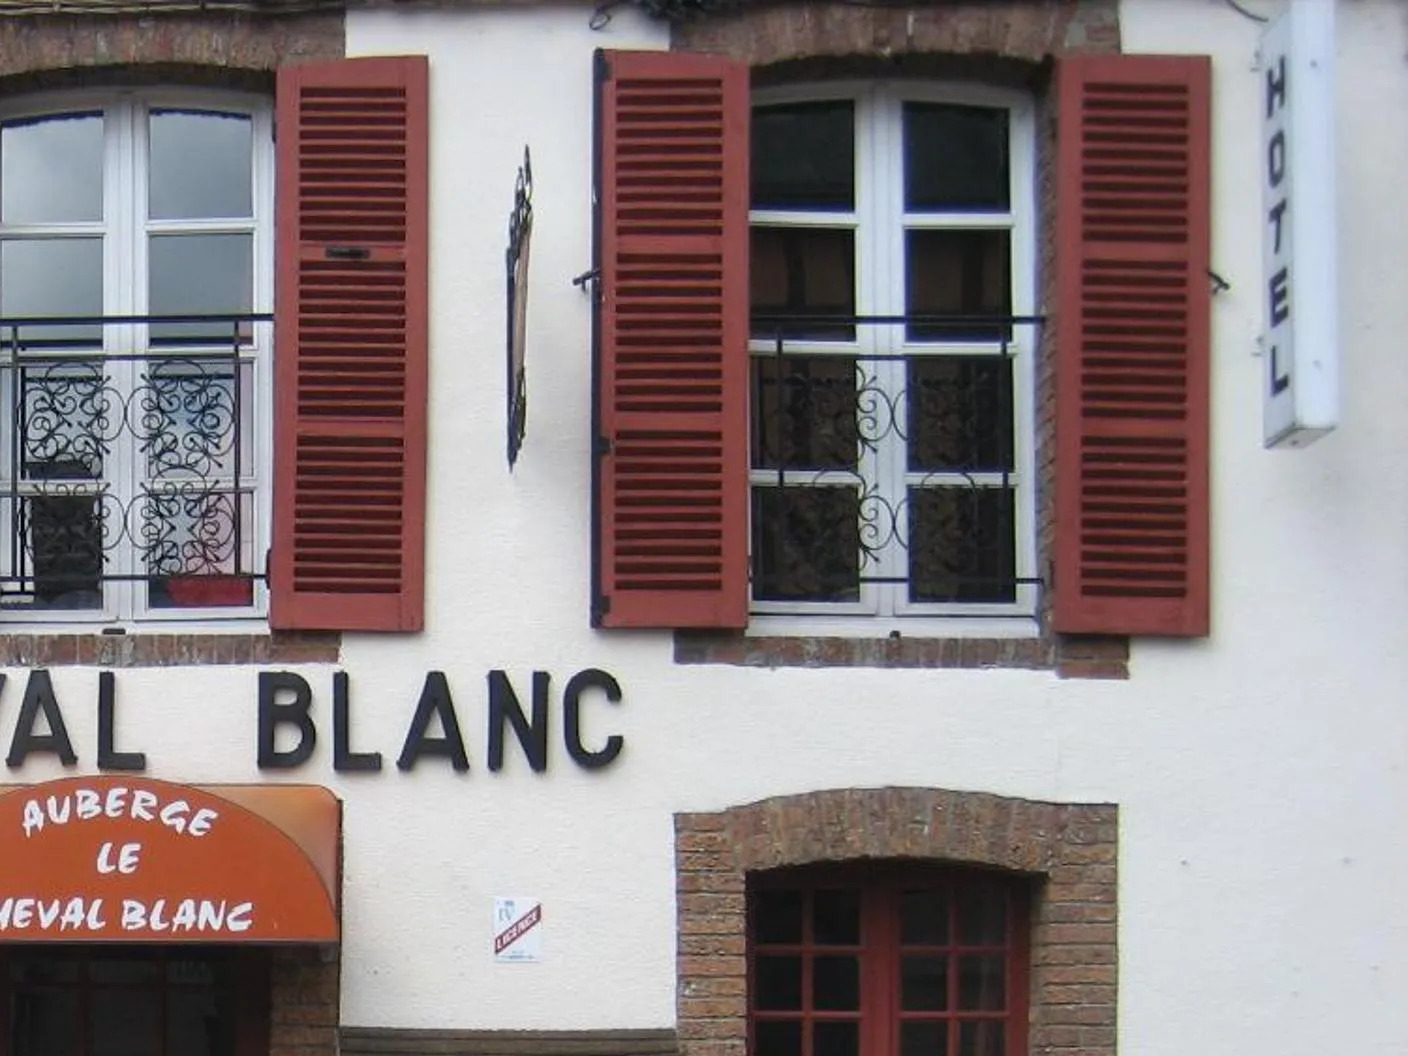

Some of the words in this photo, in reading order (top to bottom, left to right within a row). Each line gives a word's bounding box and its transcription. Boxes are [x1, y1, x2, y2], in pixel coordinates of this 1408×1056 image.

[1266, 55, 1289, 398] HOTEL
[257, 667, 624, 774] BLANC
[21, 787, 219, 839] AUBERGE
[96, 842, 141, 875] LE
[121, 899, 254, 933] BLANC
